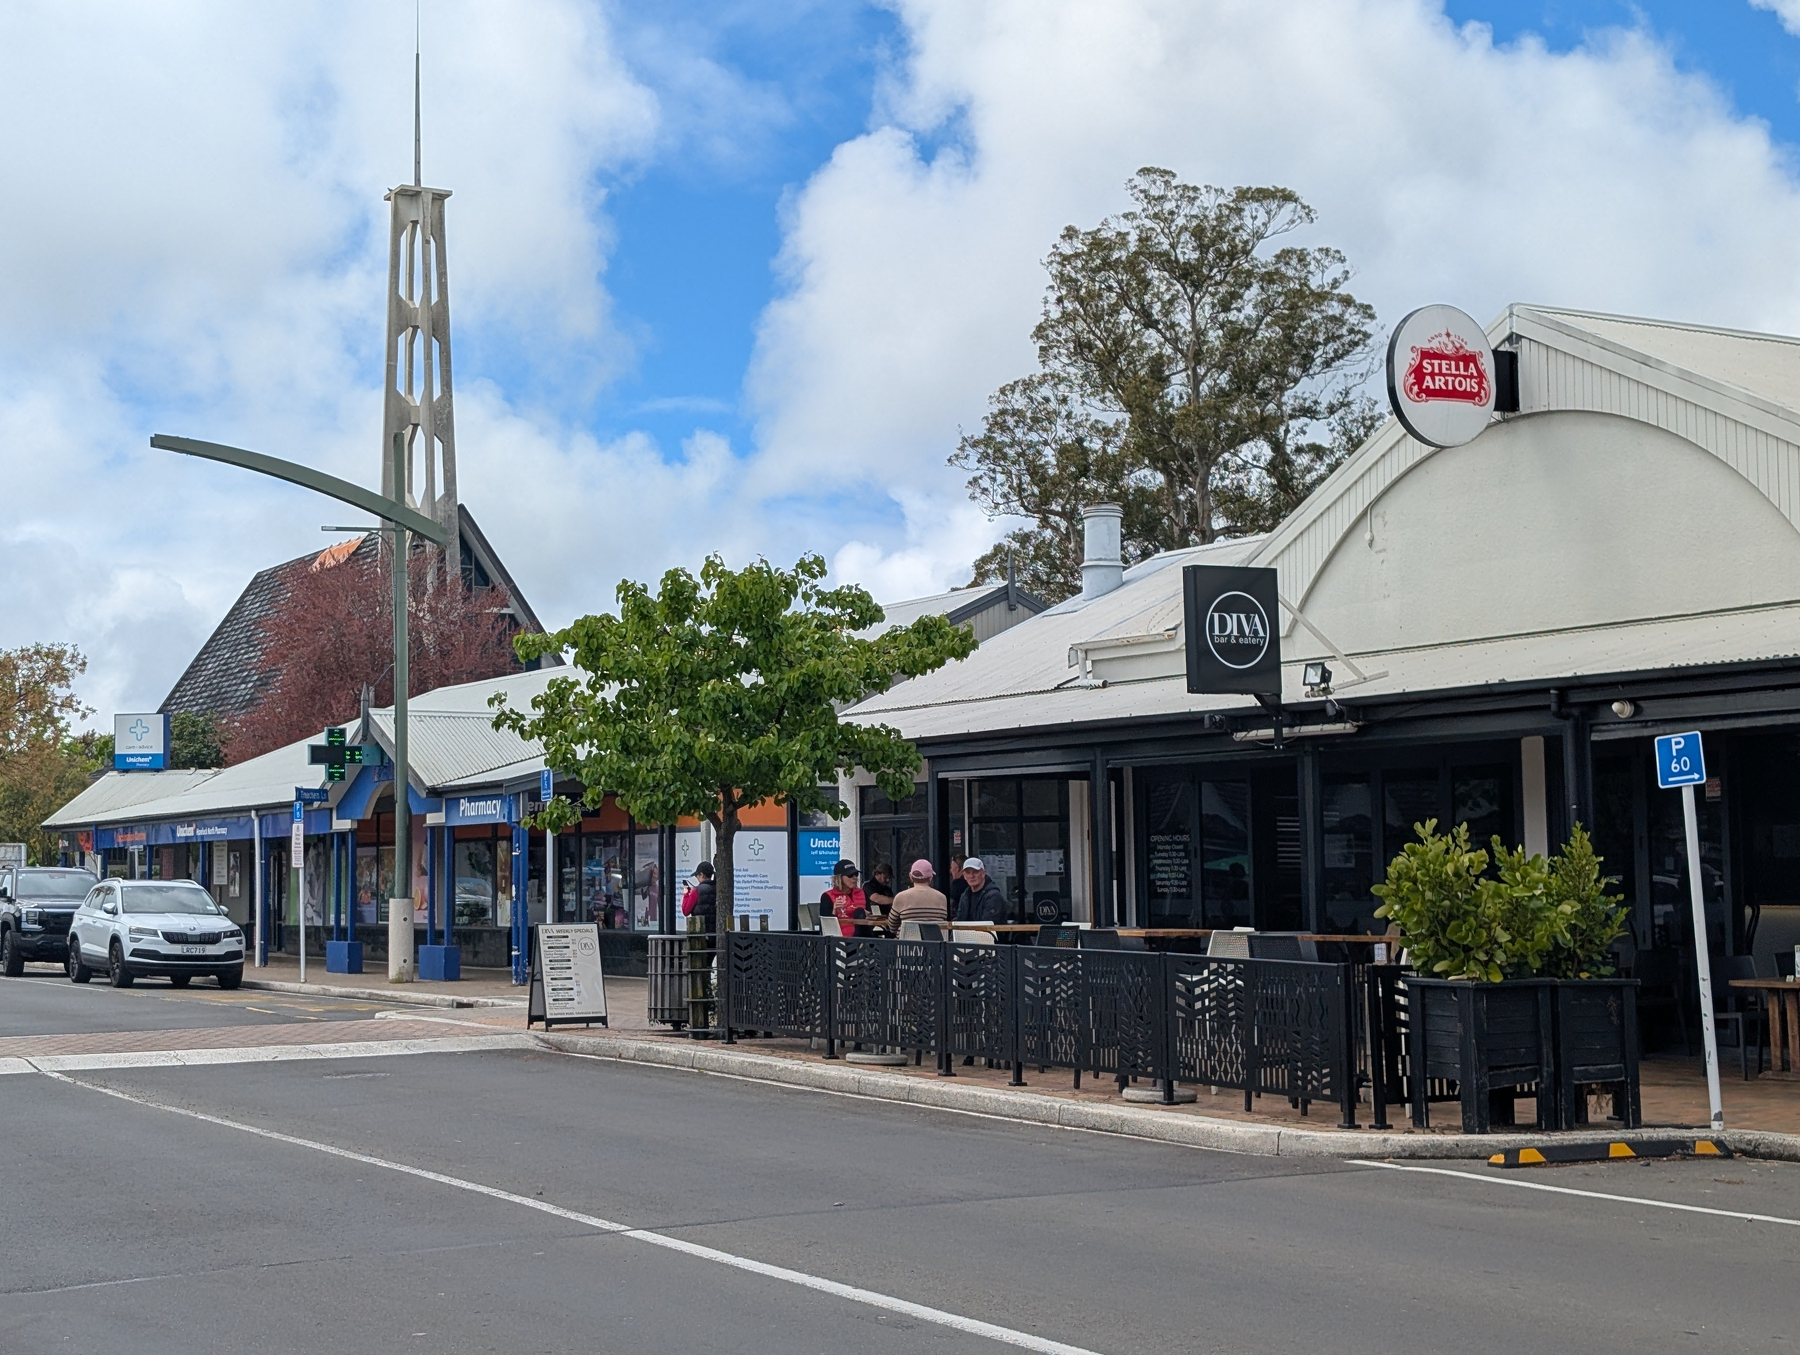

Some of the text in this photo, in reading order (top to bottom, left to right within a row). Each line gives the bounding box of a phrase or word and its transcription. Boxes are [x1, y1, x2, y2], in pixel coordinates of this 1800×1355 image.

[1427, 333, 1443, 344] ANNO
[1422, 359, 1478, 376] STELLA
[1422, 376, 1479, 393] ARTOIS
[1212, 612, 1266, 637] DIVA
[1214, 636, 1264, 646] bar & eatery
[1670, 736, 1685, 756] P
[1670, 756, 1690, 773] 60
[544, 771, 548, 781] P
[459, 798, 502, 819] Pharmacy
[176, 824, 194, 837] Unichem
[810, 838, 840, 848] Unich
